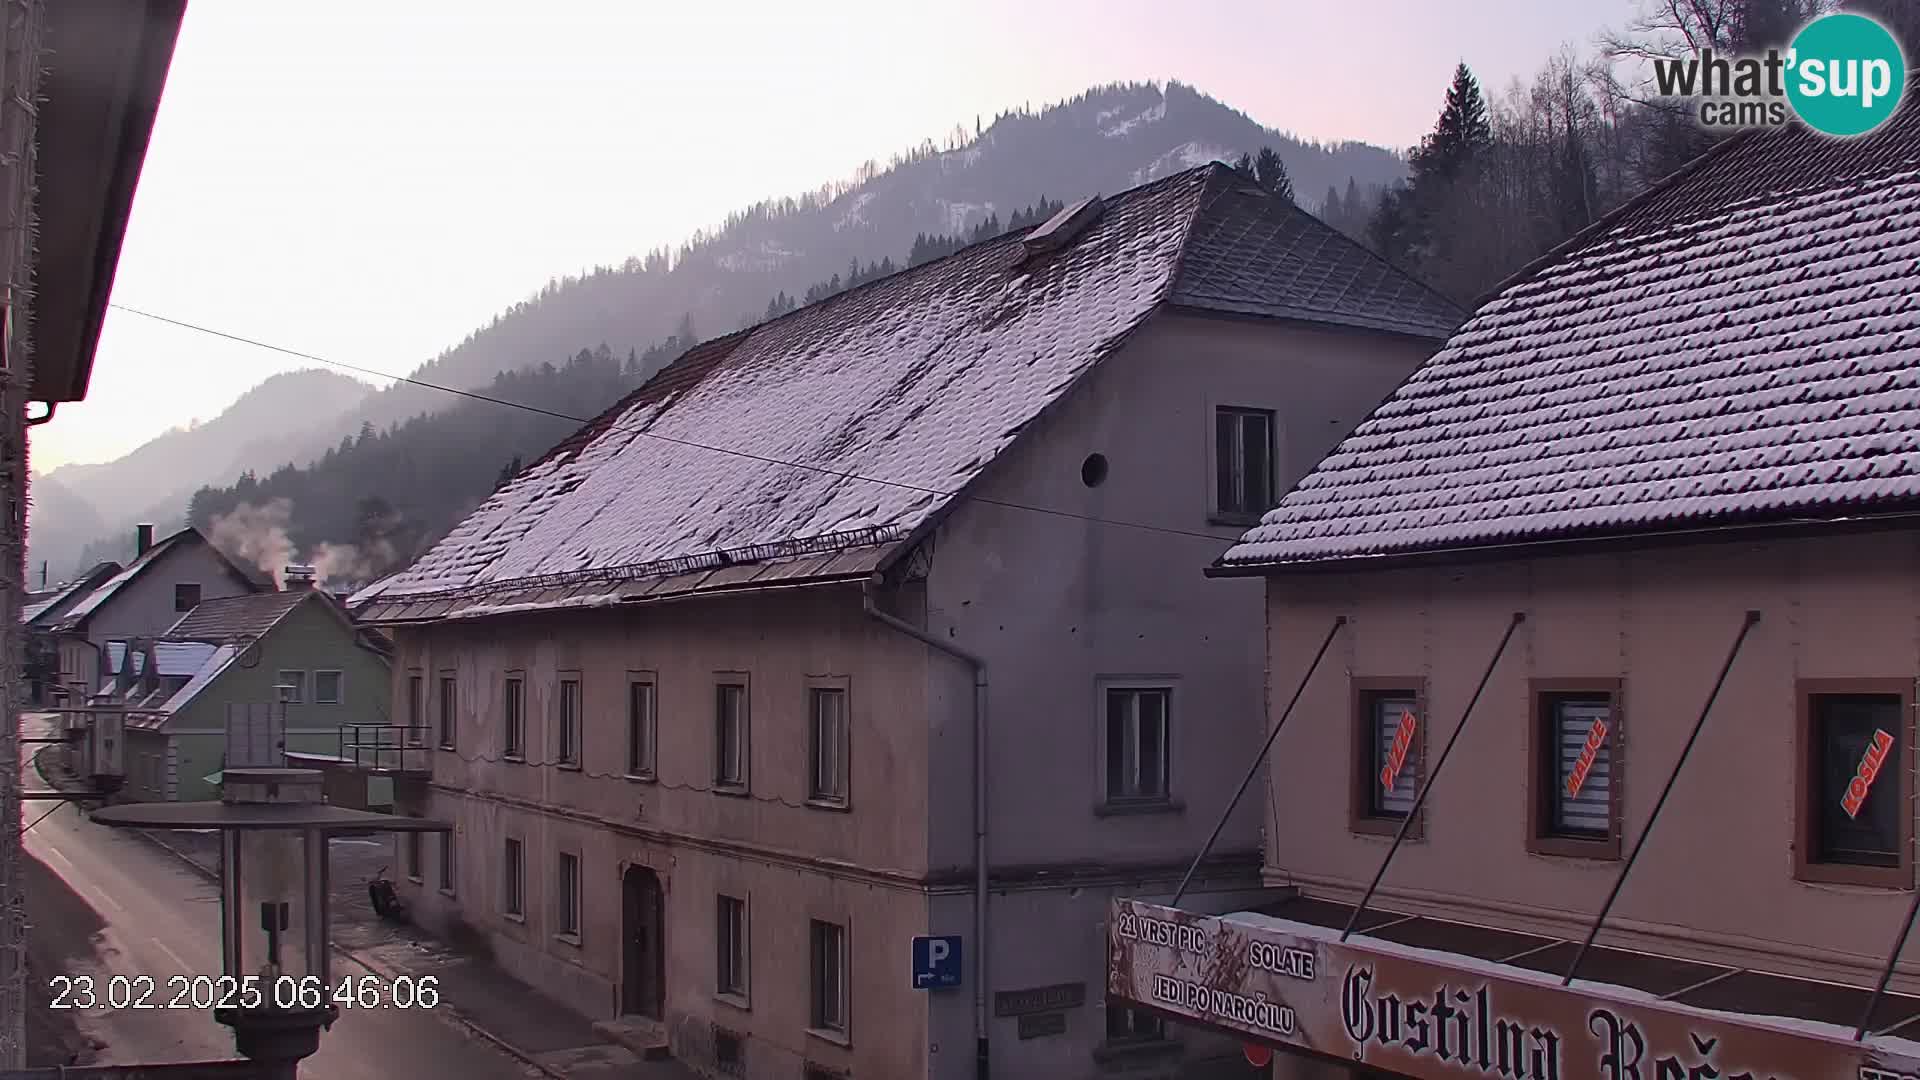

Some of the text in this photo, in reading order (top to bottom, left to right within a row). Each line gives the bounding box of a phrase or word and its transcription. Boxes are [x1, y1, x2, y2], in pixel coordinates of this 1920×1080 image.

[1840, 728, 1895, 819] KOSILA
[929, 939, 950, 968] P
[1119, 913, 1137, 939] 21
[1139, 917, 1177, 947] VRST
[1250, 942, 1314, 979] SOLATE
[1153, 975, 1294, 1034] JEDI PO NAROČILU
[1341, 962, 1560, 1080] Gostilna
